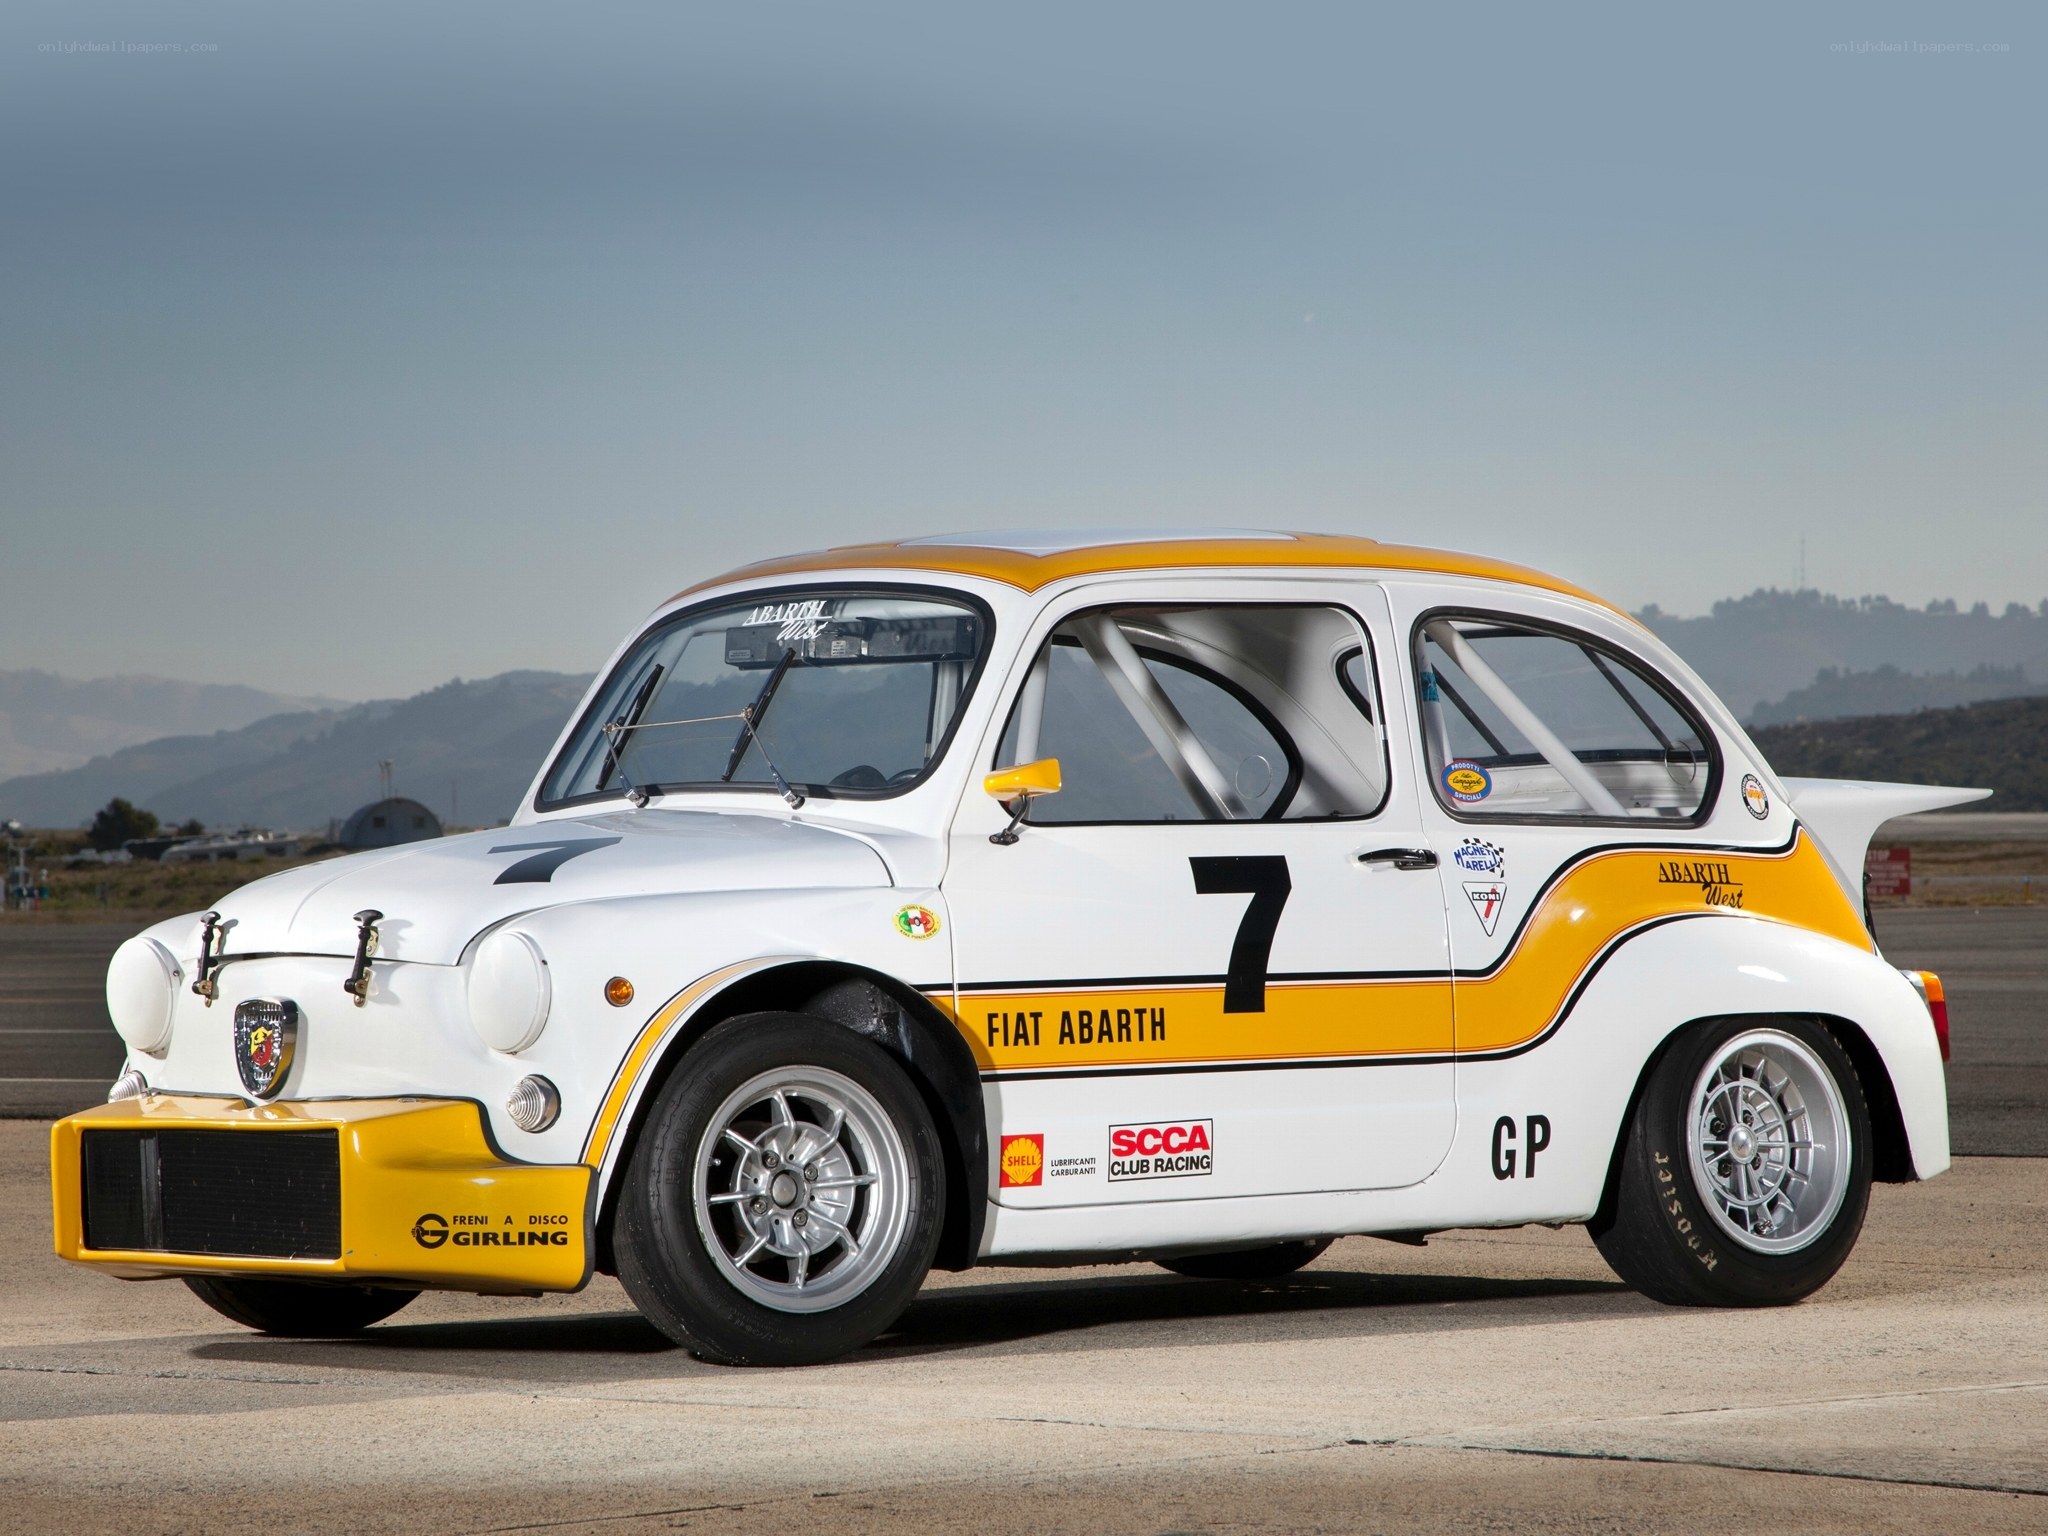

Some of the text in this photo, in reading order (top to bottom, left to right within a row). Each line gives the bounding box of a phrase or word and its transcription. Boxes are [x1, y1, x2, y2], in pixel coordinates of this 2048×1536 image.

[742, 600, 829, 626] ABARTH
[776, 619, 828, 641] West
[1450, 762, 1481, 772] PRODOTTI
[1454, 791, 1482, 801] SPECIALI
[487, 837, 622, 886] 7
[1658, 862, 1733, 885] ABARTH
[1472, 892, 1500, 900] KONI
[1702, 883, 1744, 909] West
[1188, 855, 1292, 1013] 7
[987, 1007, 1165, 1047] FIAT ABARTH
[1111, 1124, 1210, 1158] SCCA
[1491, 1114, 1552, 1180] GP
[1007, 1155, 1036, 1167] SHELL
[1050, 1157, 1096, 1167] LUBRIFICANTI
[1050, 1167, 1096, 1177] CARBURANTI
[1110, 1154, 1211, 1177] CLUB RACING
[452, 1215, 569, 1225] FRENI A DISCO
[452, 1231, 568, 1246] GIRLING
